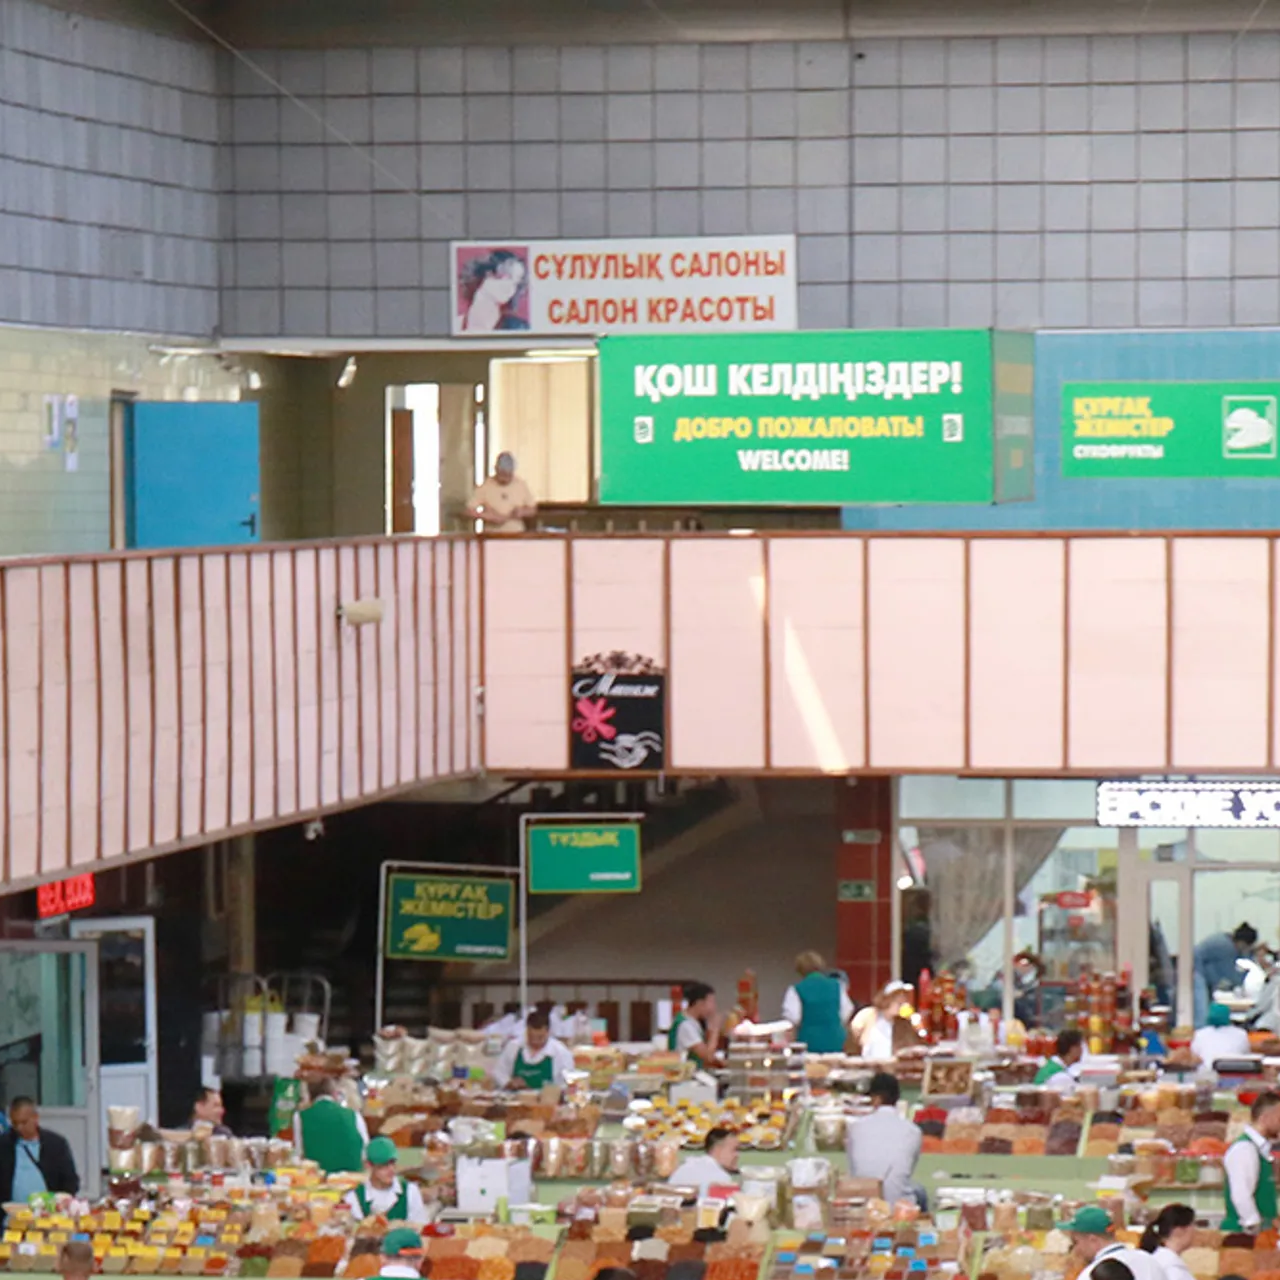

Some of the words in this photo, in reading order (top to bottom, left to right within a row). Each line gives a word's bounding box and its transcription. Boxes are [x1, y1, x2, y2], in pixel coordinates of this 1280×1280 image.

[534, 252, 663, 282] СҰЛУЛЫҚ
[670, 249, 785, 278] САЛОНЫ
[548, 299, 638, 324] САЛОН
[647, 296, 775, 323] КРАСОТЫ
[634, 363, 717, 403] ҚОШ
[728, 360, 962, 401] КЕЛДІҢІЗДЕР!
[673, 416, 752, 441] ДОБРО
[757, 416, 924, 439] ПОЖАЛОВАТЬ!
[737, 449, 850, 471] WELCOME!
